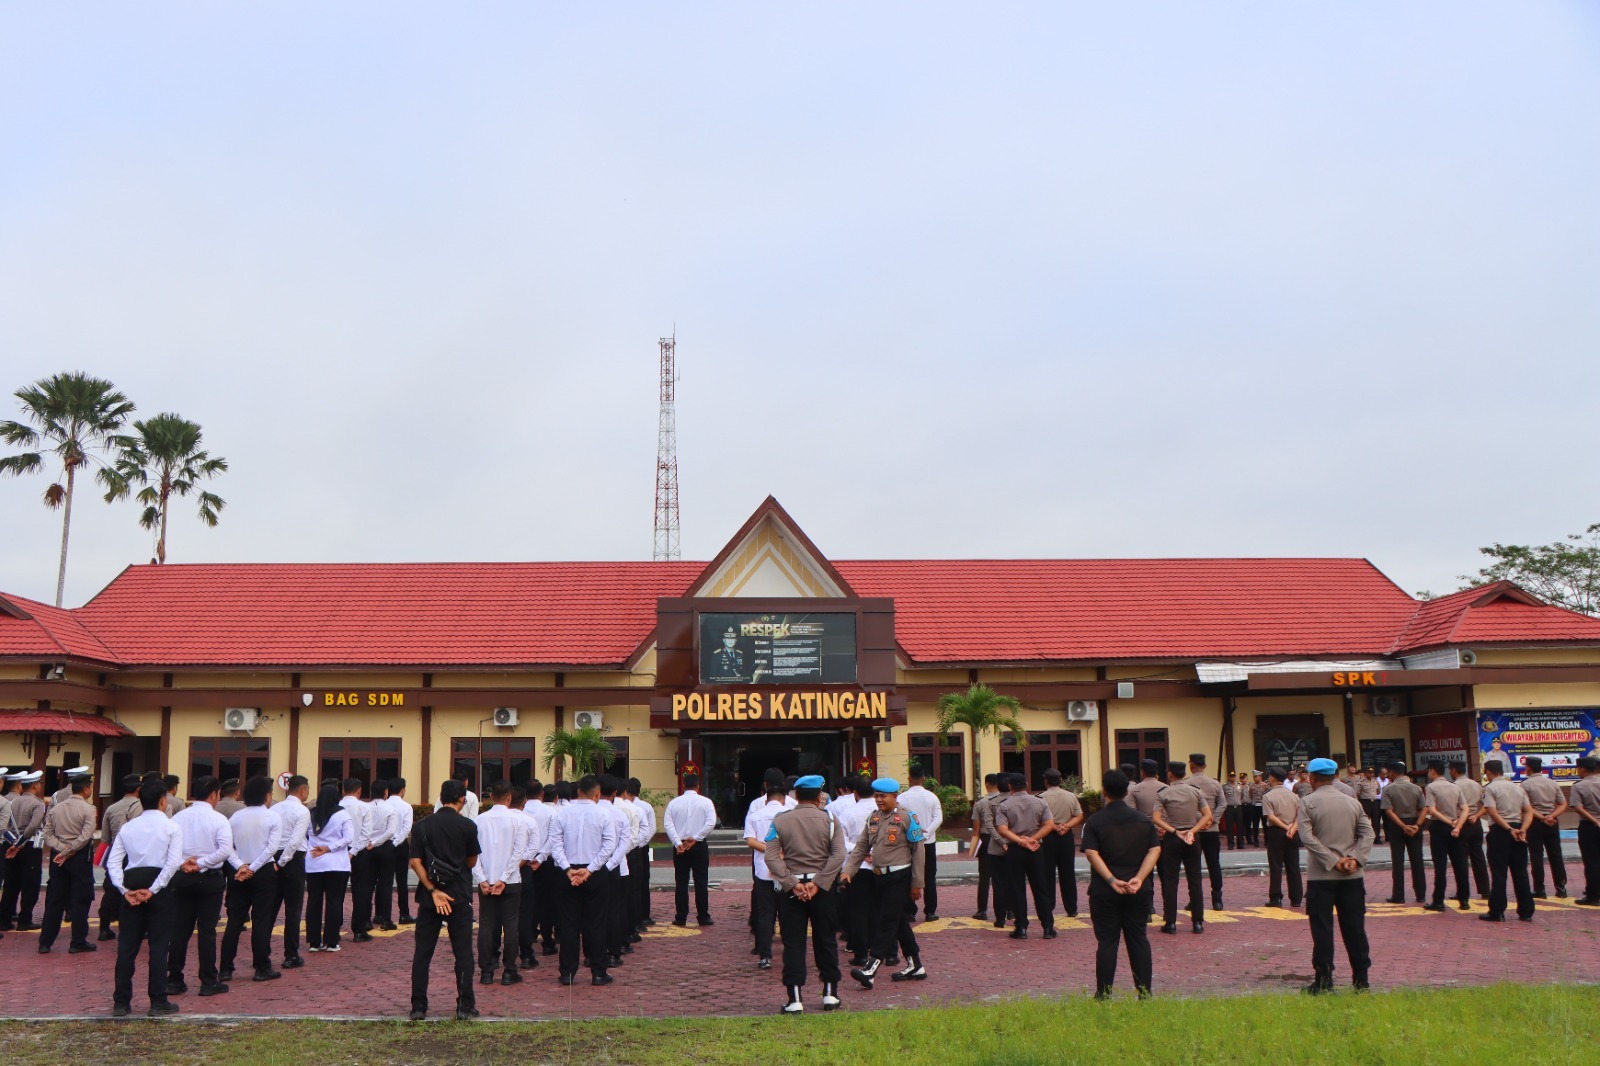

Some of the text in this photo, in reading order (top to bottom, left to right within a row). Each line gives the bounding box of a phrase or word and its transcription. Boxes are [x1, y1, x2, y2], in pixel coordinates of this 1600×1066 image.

[741, 624, 790, 636] RESPEK
[325, 693, 404, 706] BAG SDM
[672, 692, 886, 720] POLRES KATINGAN
[1509, 721, 1580, 730] POLRES KATINGAN
[1506, 732, 1585, 741] WILAYAH ZONA INTEGRITAS
[1419, 737, 1463, 750] POLRI UNTUK
